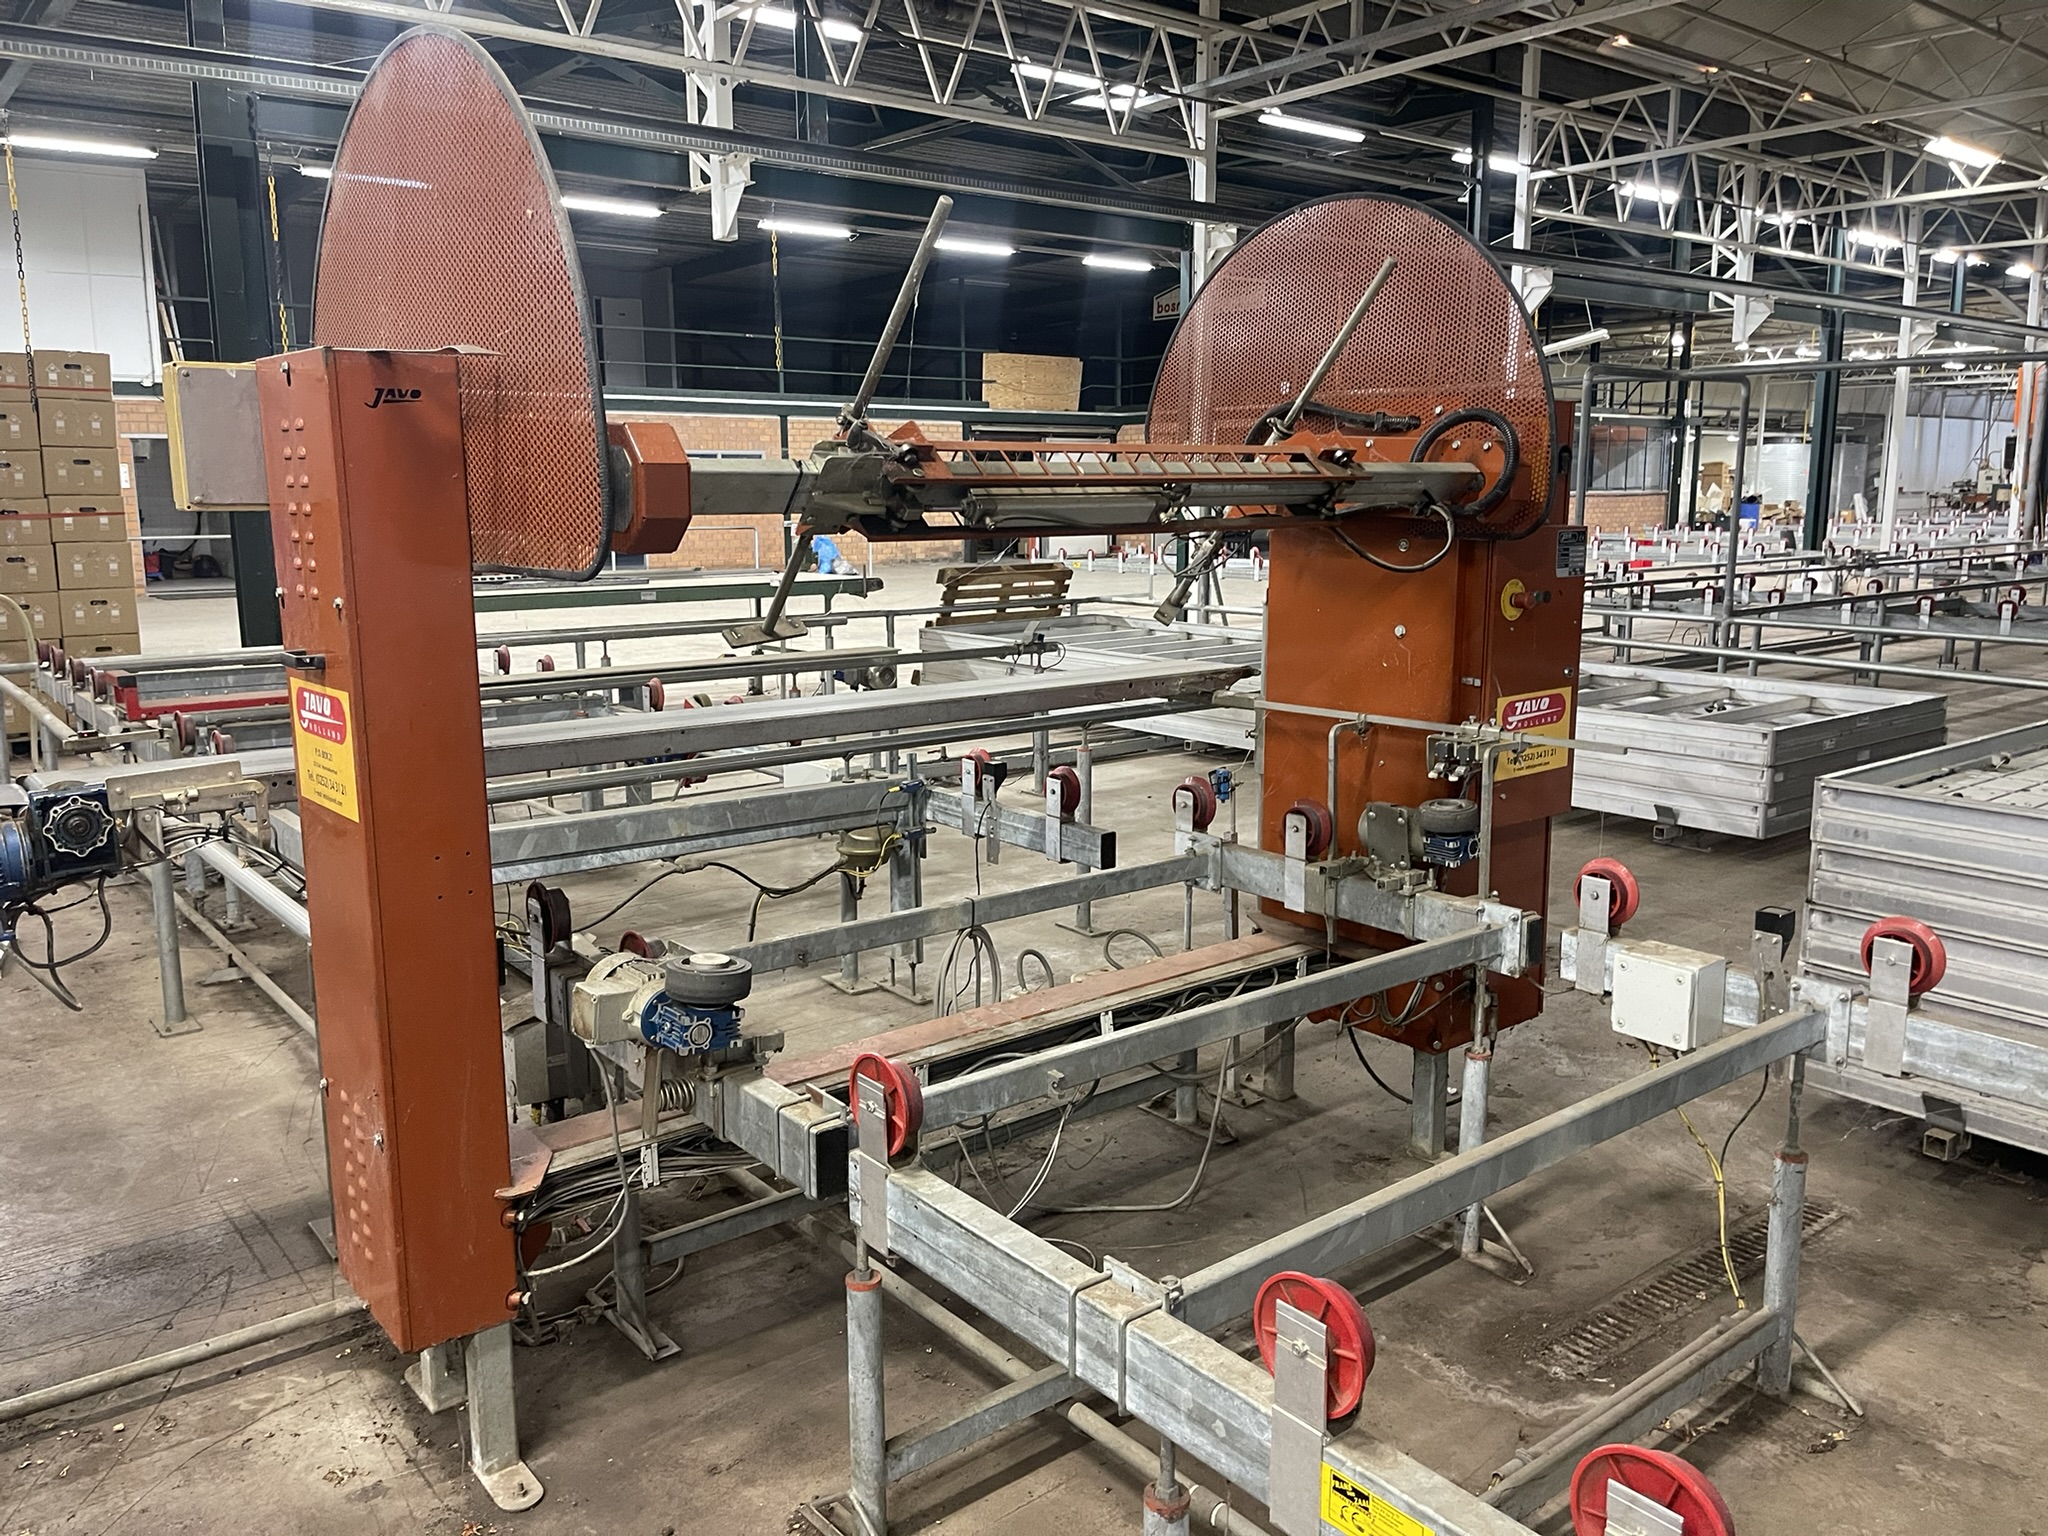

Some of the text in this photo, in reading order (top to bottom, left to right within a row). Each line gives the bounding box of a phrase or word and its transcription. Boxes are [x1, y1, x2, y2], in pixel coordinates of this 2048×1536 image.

[363, 387, 422, 409] JAVO
[301, 691, 331, 728] JAVO
[1508, 697, 1550, 727] JAVO
[309, 722, 341, 741] HOLLAND
[1517, 715, 1558, 728] HOLLAND
